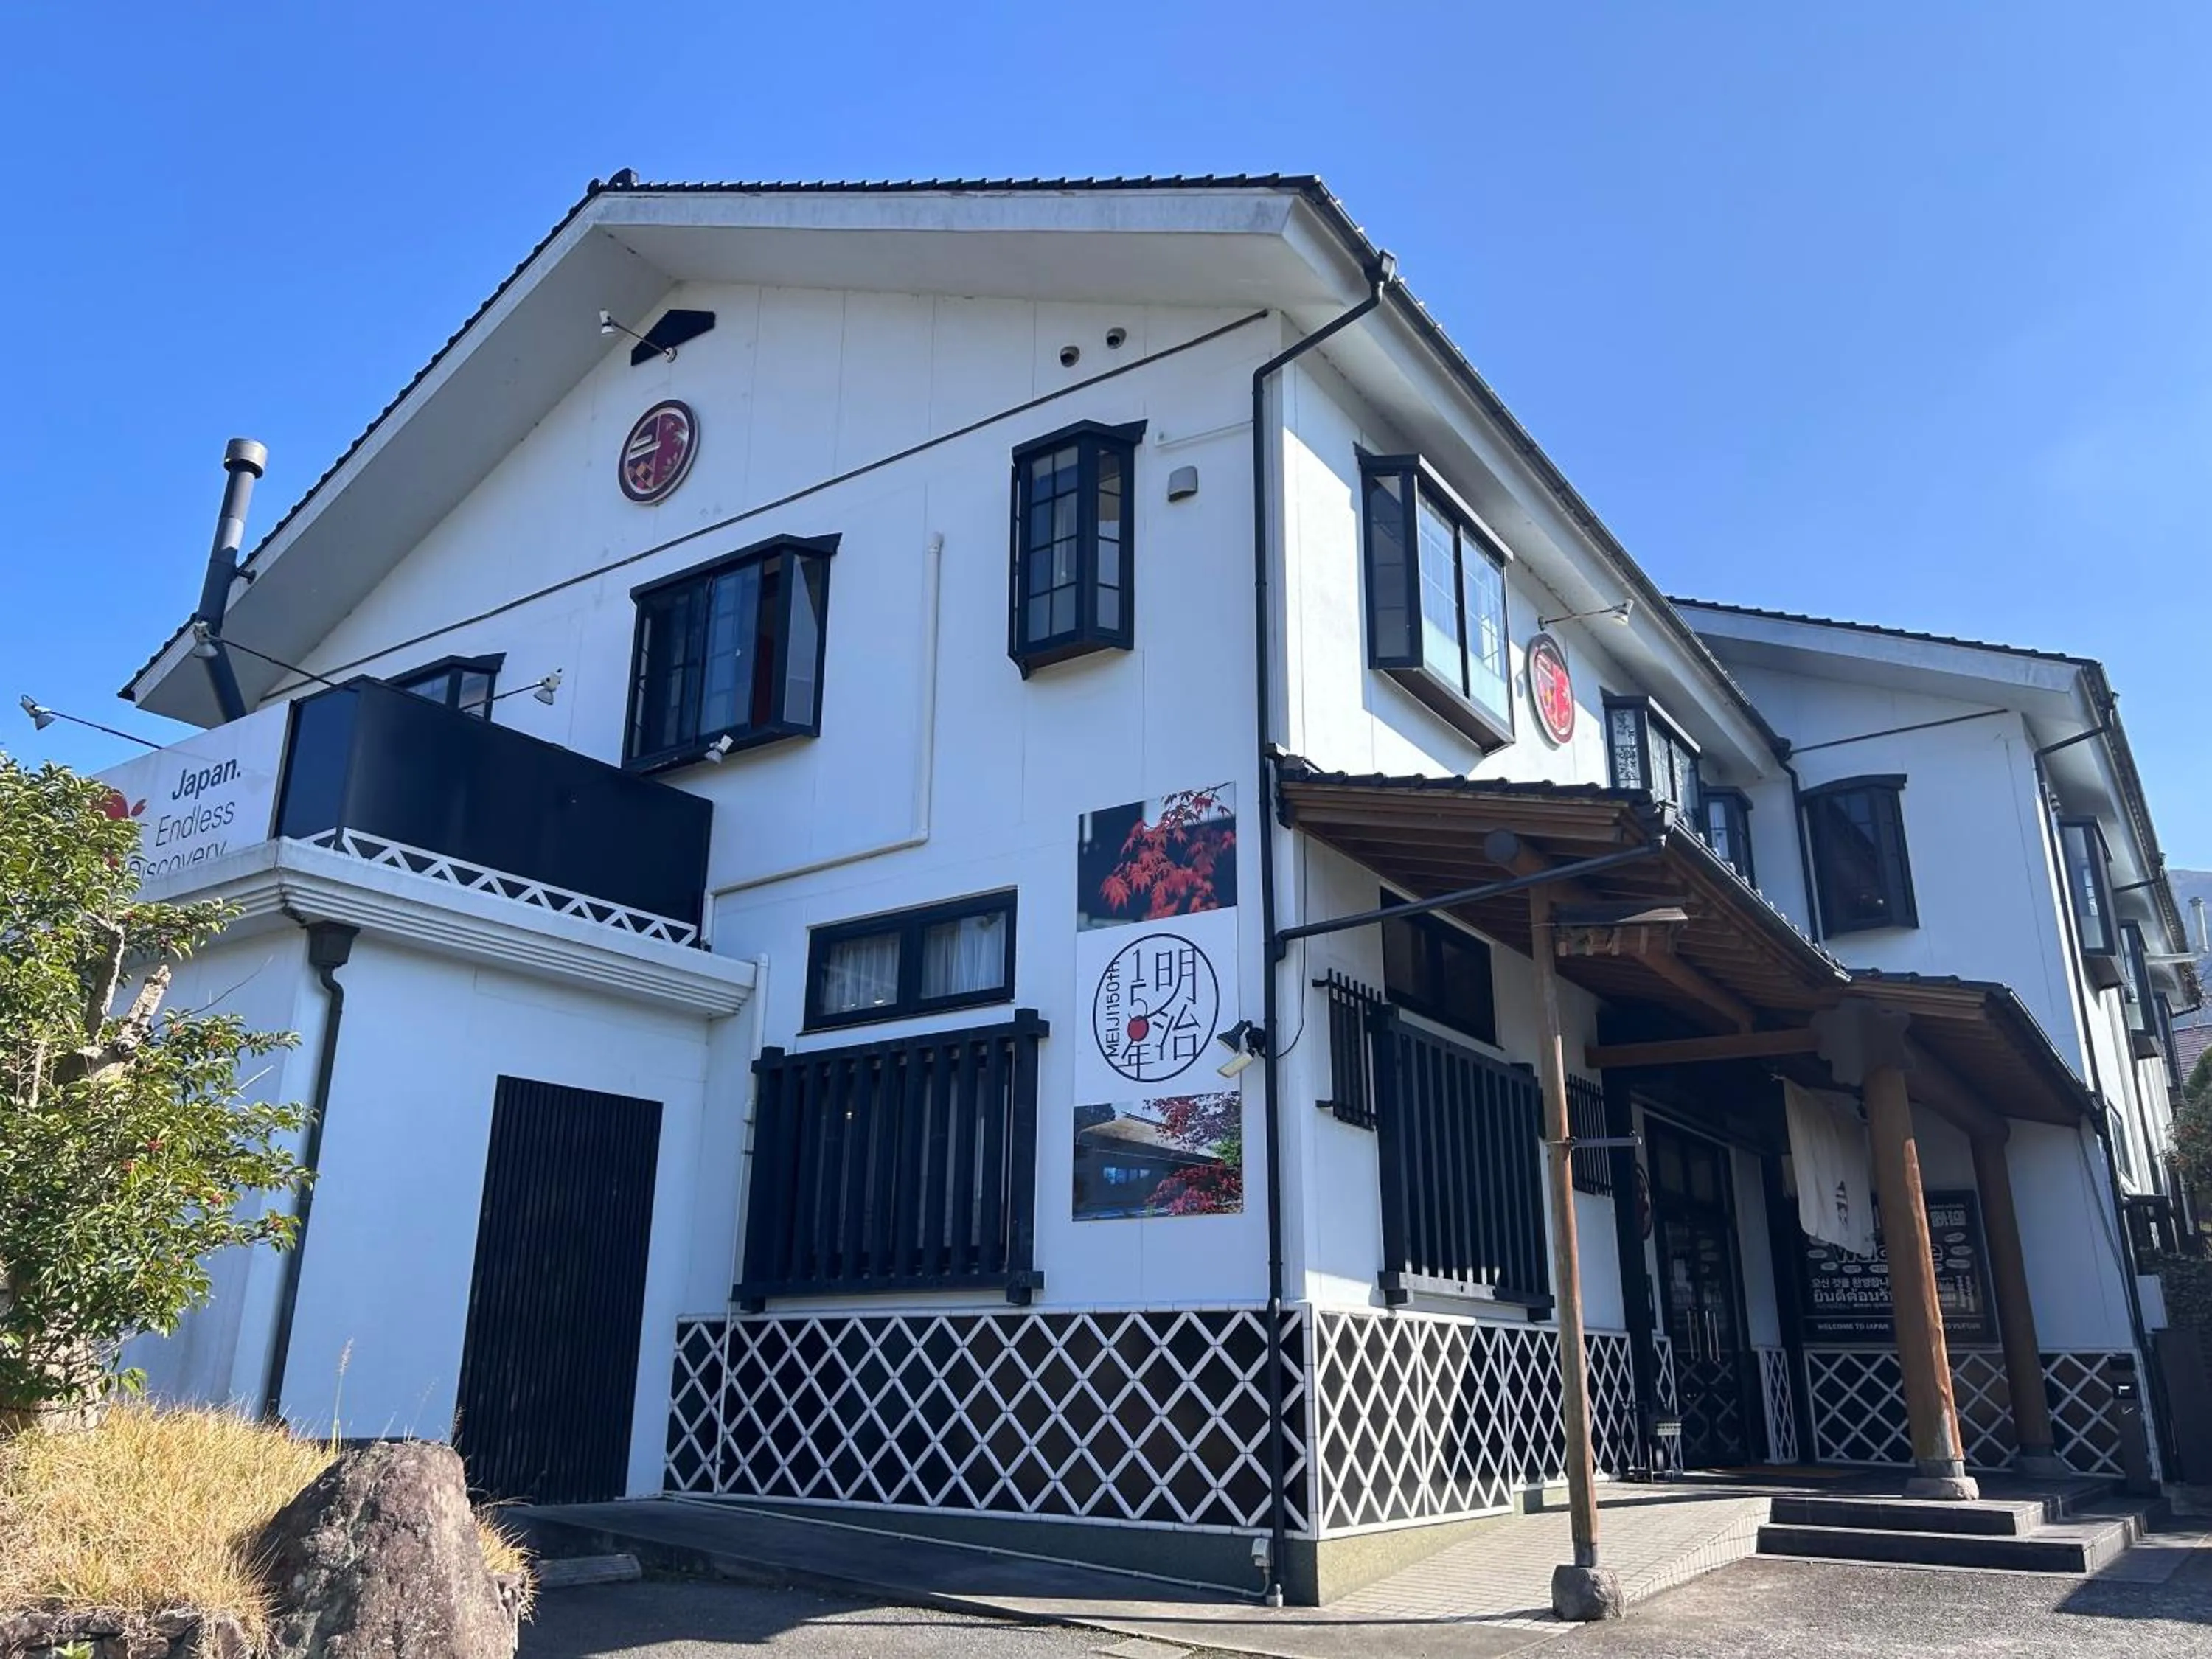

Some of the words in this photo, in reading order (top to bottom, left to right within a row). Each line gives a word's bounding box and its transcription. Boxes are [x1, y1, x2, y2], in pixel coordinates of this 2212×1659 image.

[172, 759, 241, 800] Japan.
[156, 801, 235, 847] Endless
[1149, 947, 1201, 1061] 明治
[1814, 1289, 1893, 1303] ยินดีต้อนรั
